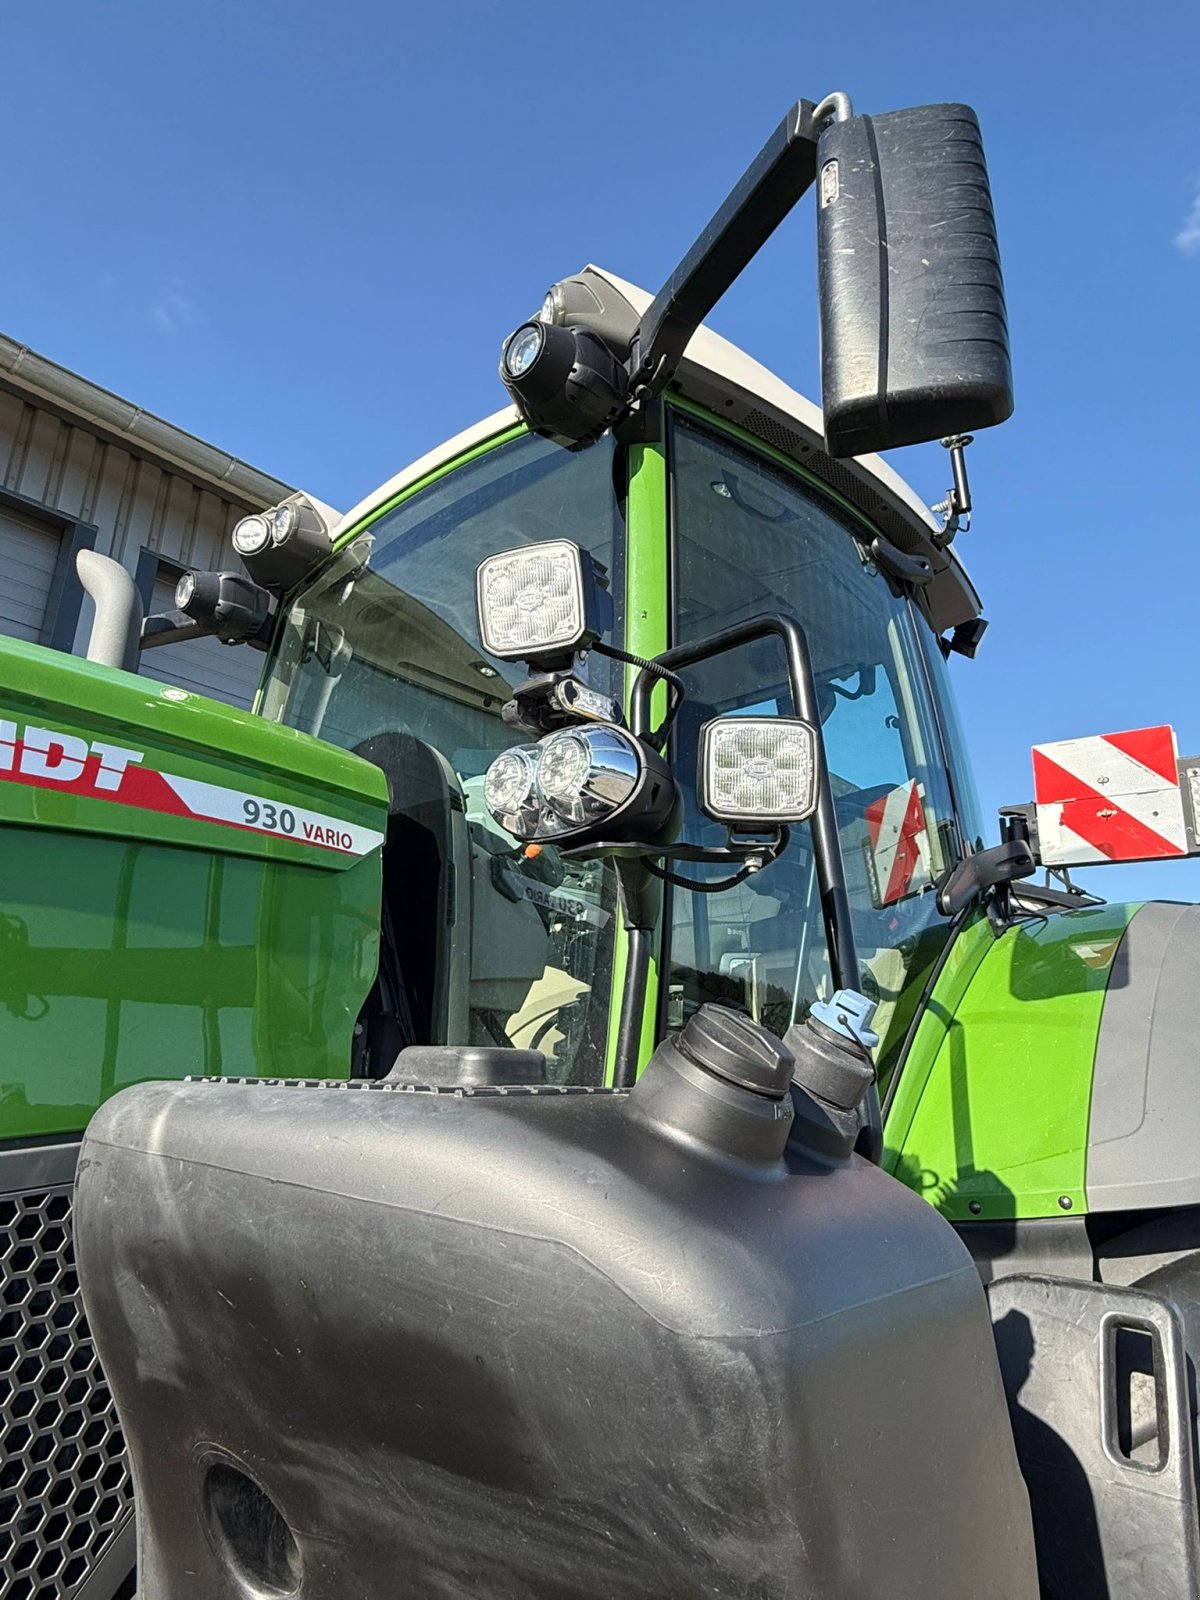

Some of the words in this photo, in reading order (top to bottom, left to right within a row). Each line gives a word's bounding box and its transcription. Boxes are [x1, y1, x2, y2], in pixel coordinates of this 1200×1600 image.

[0, 719, 145, 792] DT
[243, 799, 296, 834] 930
[302, 821, 353, 849] VARIO
